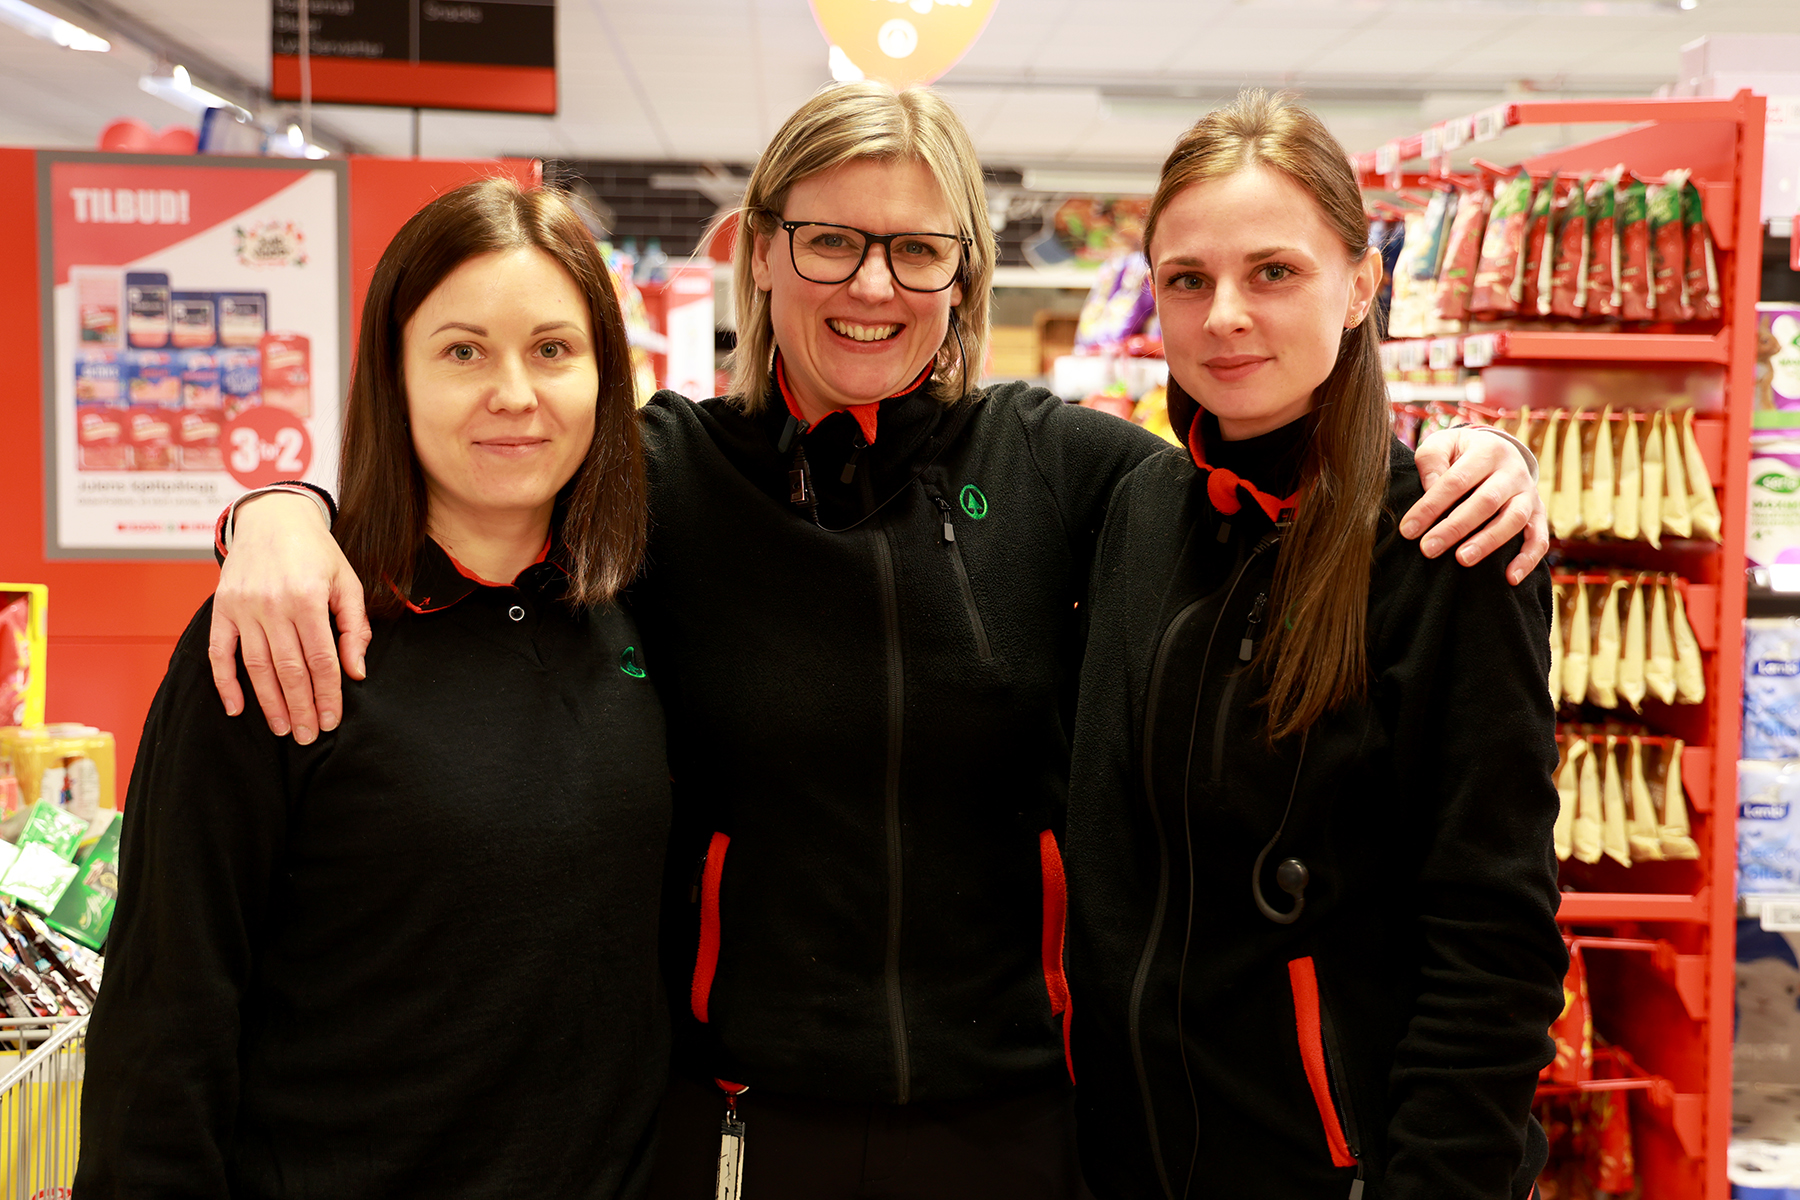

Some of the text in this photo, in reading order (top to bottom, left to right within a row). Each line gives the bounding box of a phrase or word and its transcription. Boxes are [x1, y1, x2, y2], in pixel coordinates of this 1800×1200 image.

[70, 188, 190, 224] TILBUD!
[230, 427, 259, 472] 3
[275, 427, 303, 472] 2
[1744, 803, 1786, 819] Lambi
